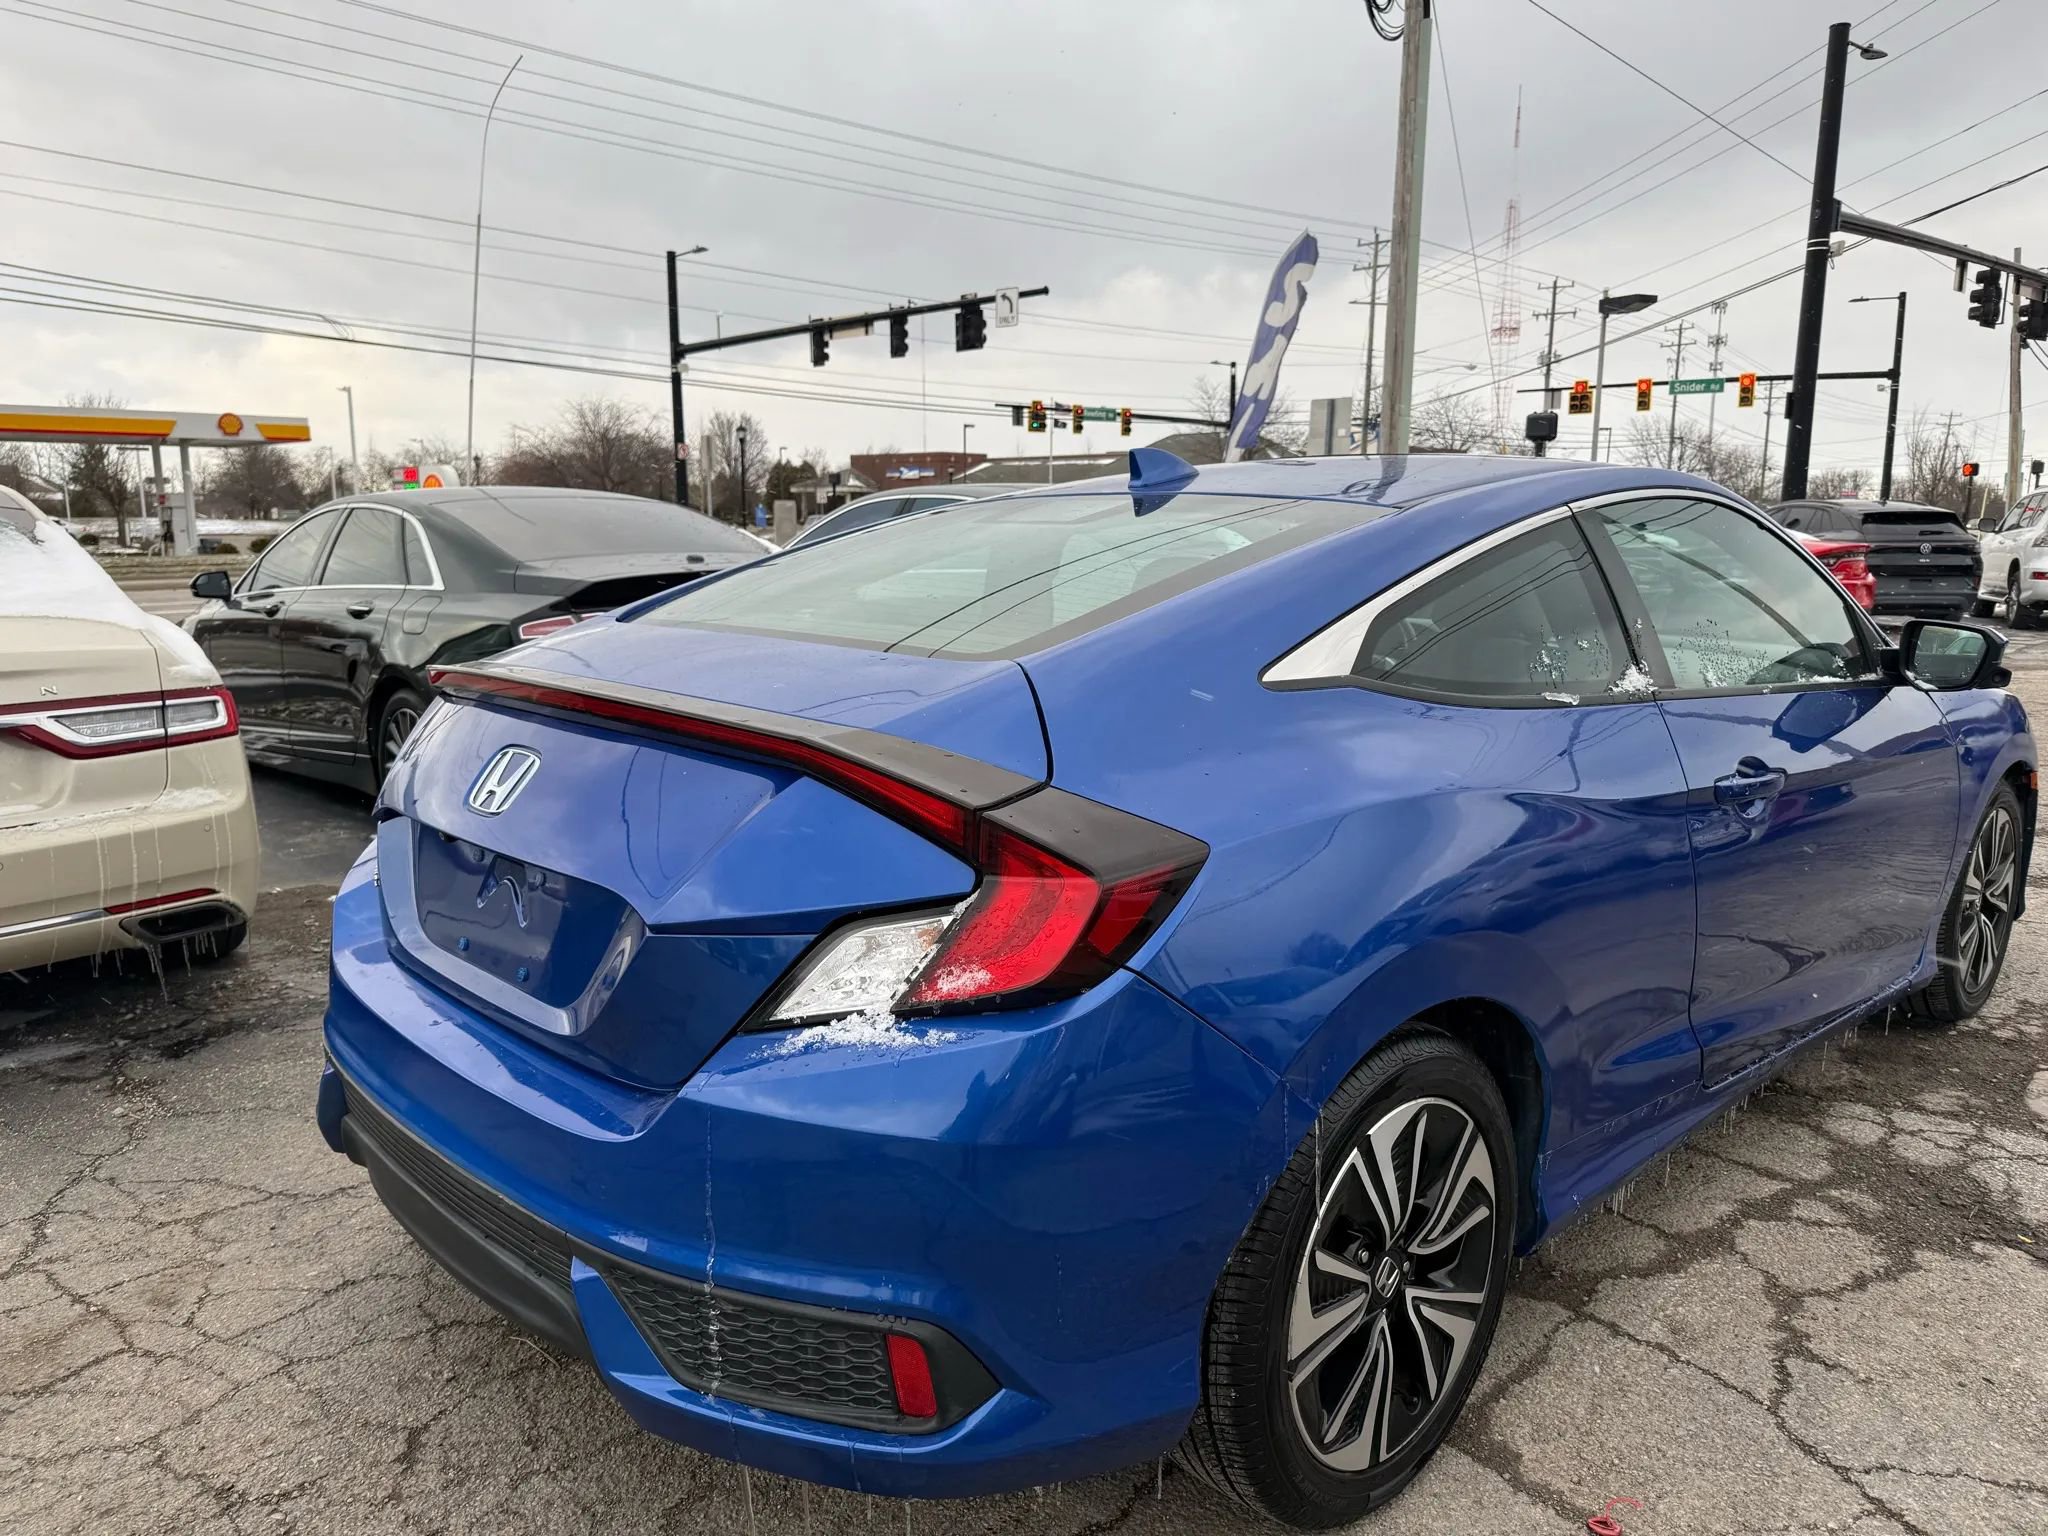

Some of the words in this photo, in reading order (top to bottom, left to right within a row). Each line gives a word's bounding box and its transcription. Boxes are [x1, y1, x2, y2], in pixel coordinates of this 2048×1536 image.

[999, 315, 1015, 325] ONLY
[1222, 262, 1316, 463] SAL
[1674, 382, 1706, 393] Snider
